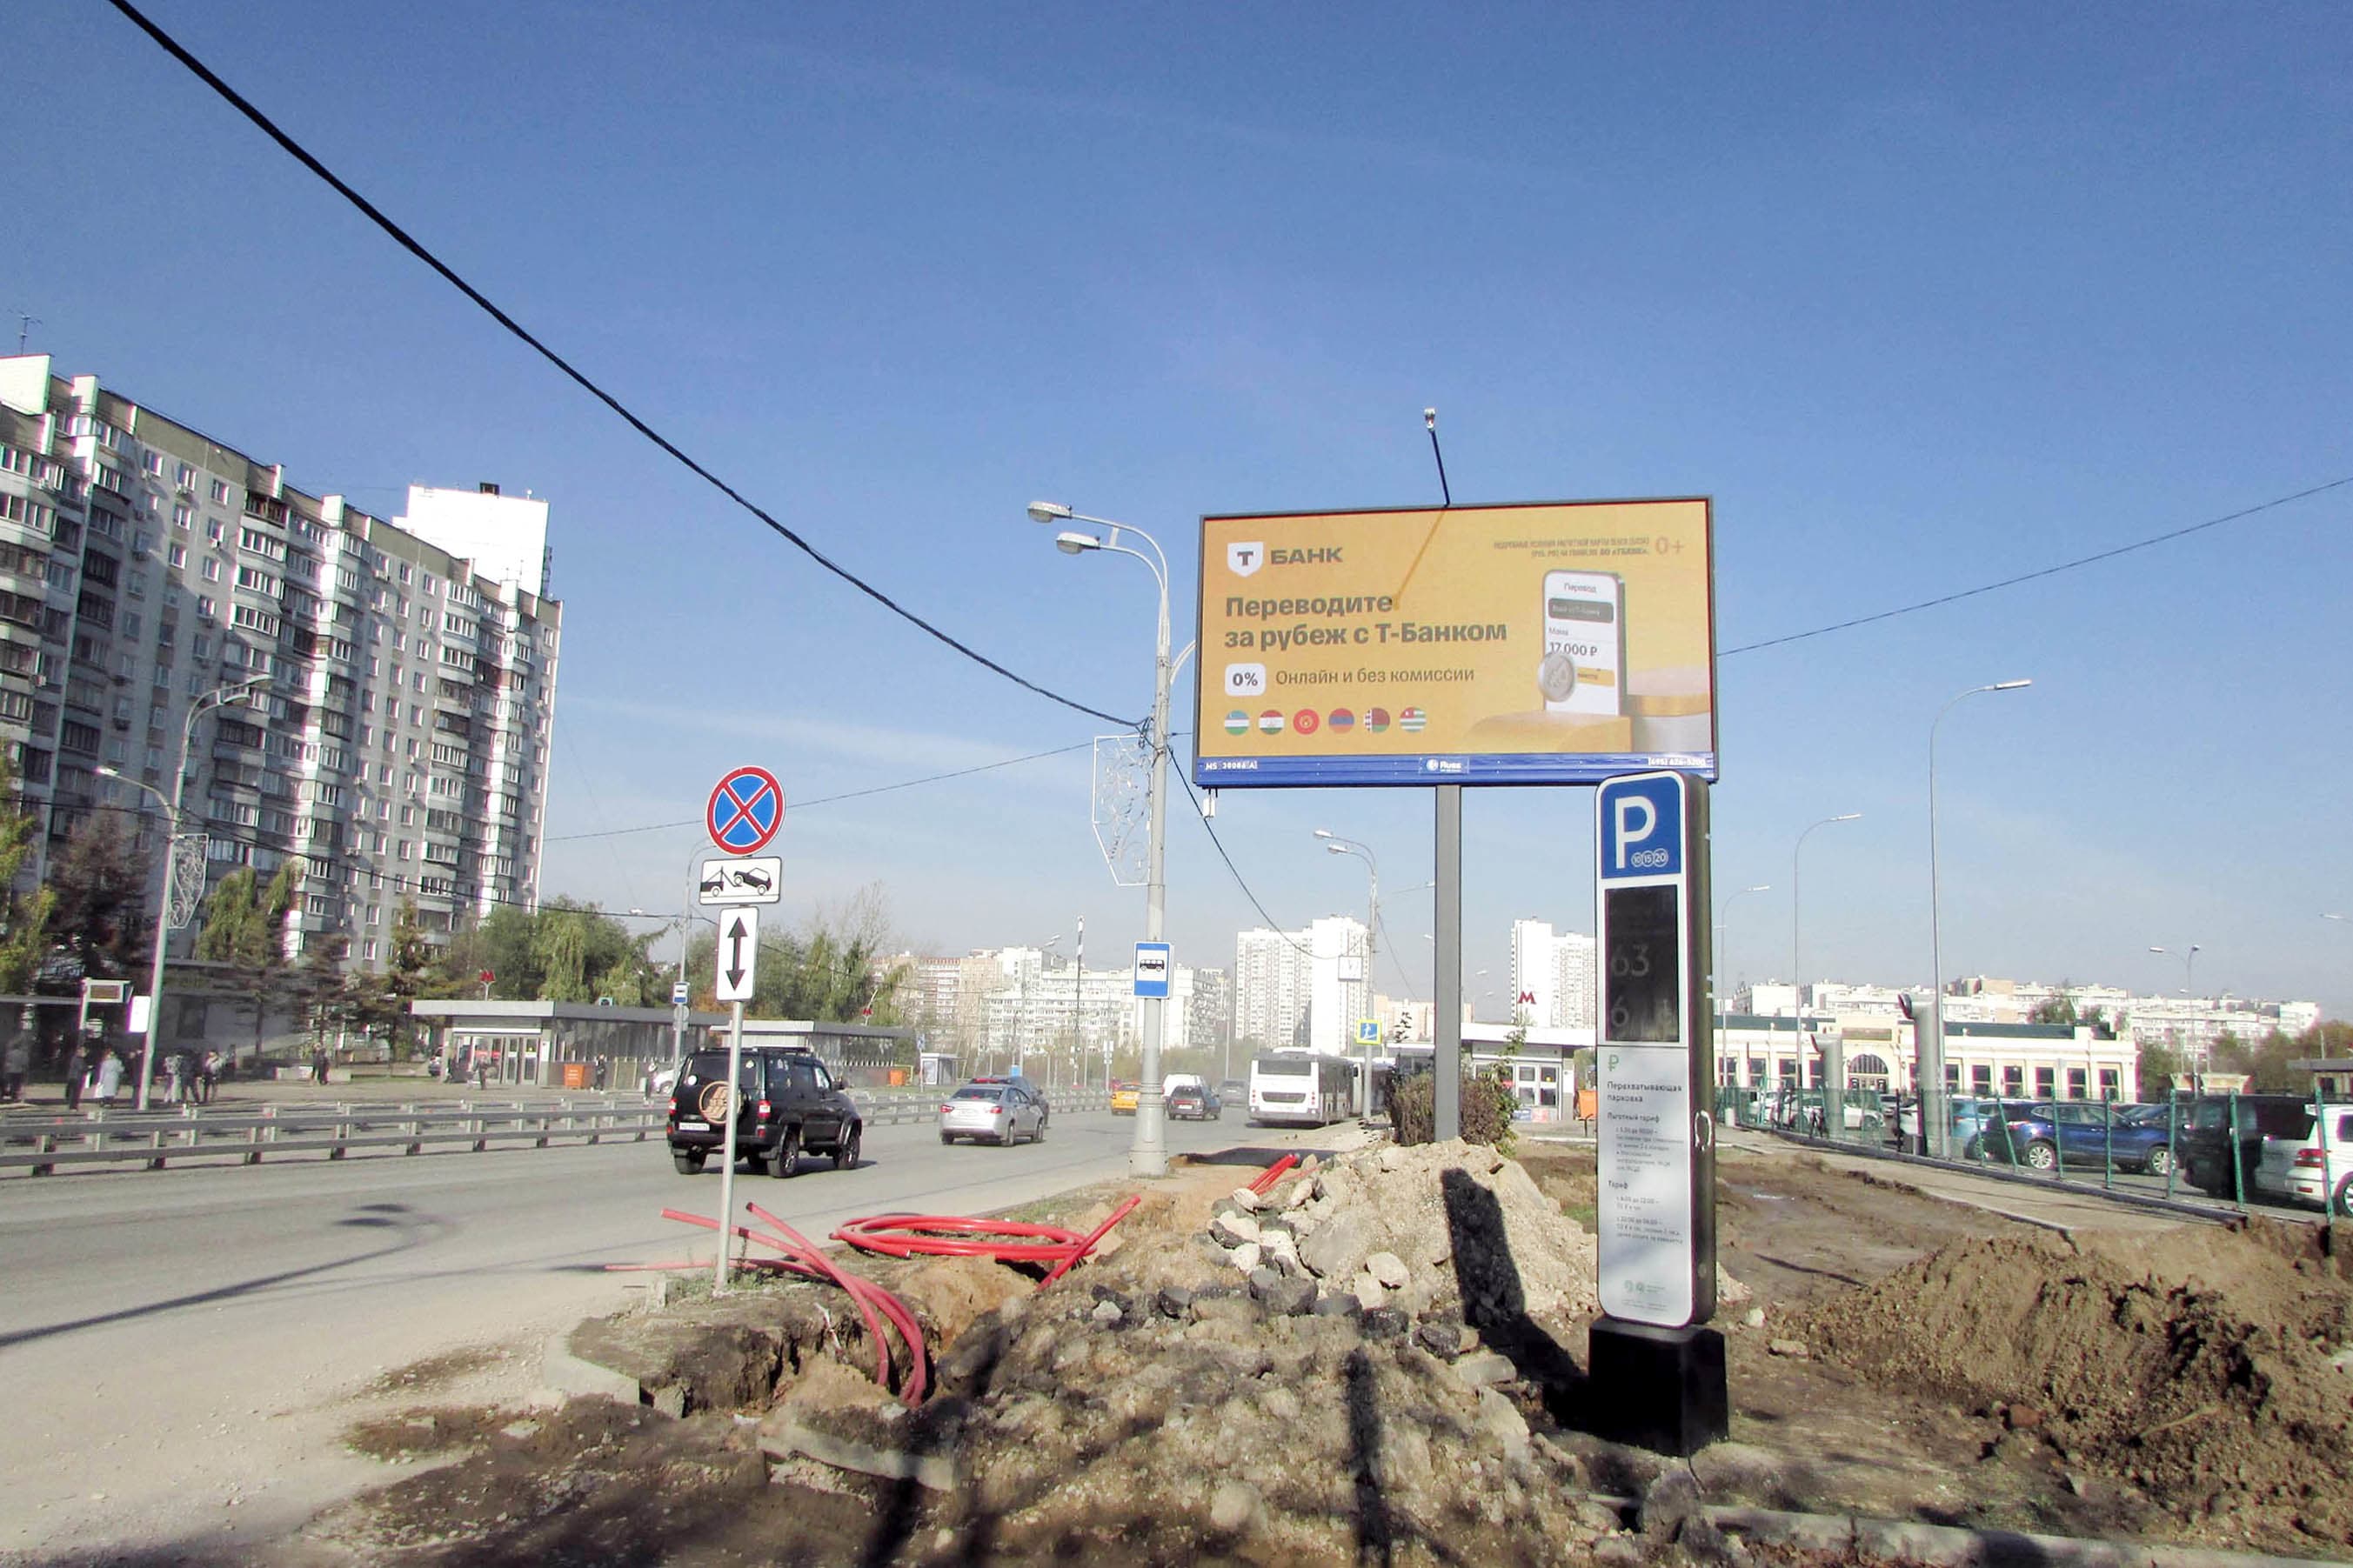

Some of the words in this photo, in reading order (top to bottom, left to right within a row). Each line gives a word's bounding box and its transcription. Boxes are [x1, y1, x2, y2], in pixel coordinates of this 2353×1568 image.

[1655, 537, 1684, 555] 0+
[1270, 547, 1343, 564] БАНК
[1564, 583, 1597, 593] Перевод
[1226, 596, 1394, 621] Переводите
[1224, 629, 1254, 648] за
[1260, 624, 1347, 651] рубеж
[1354, 626, 1369, 644] с
[1374, 622, 1507, 644] Т-Банком
[1232, 672, 1259, 687] 0%
[1275, 669, 1339, 685] Онлайн
[1341, 671, 1353, 684] и
[1357, 668, 1387, 684] без
[1390, 669, 1475, 683] комиссии
[1614, 796, 1656, 869] P
[1608, 1081, 1682, 1091] Перехватывающая
[1608, 1095, 1643, 1104] парковка
[1640, 1114, 1660, 1124] тариф
[1608, 1179, 1629, 1190] Тариф
